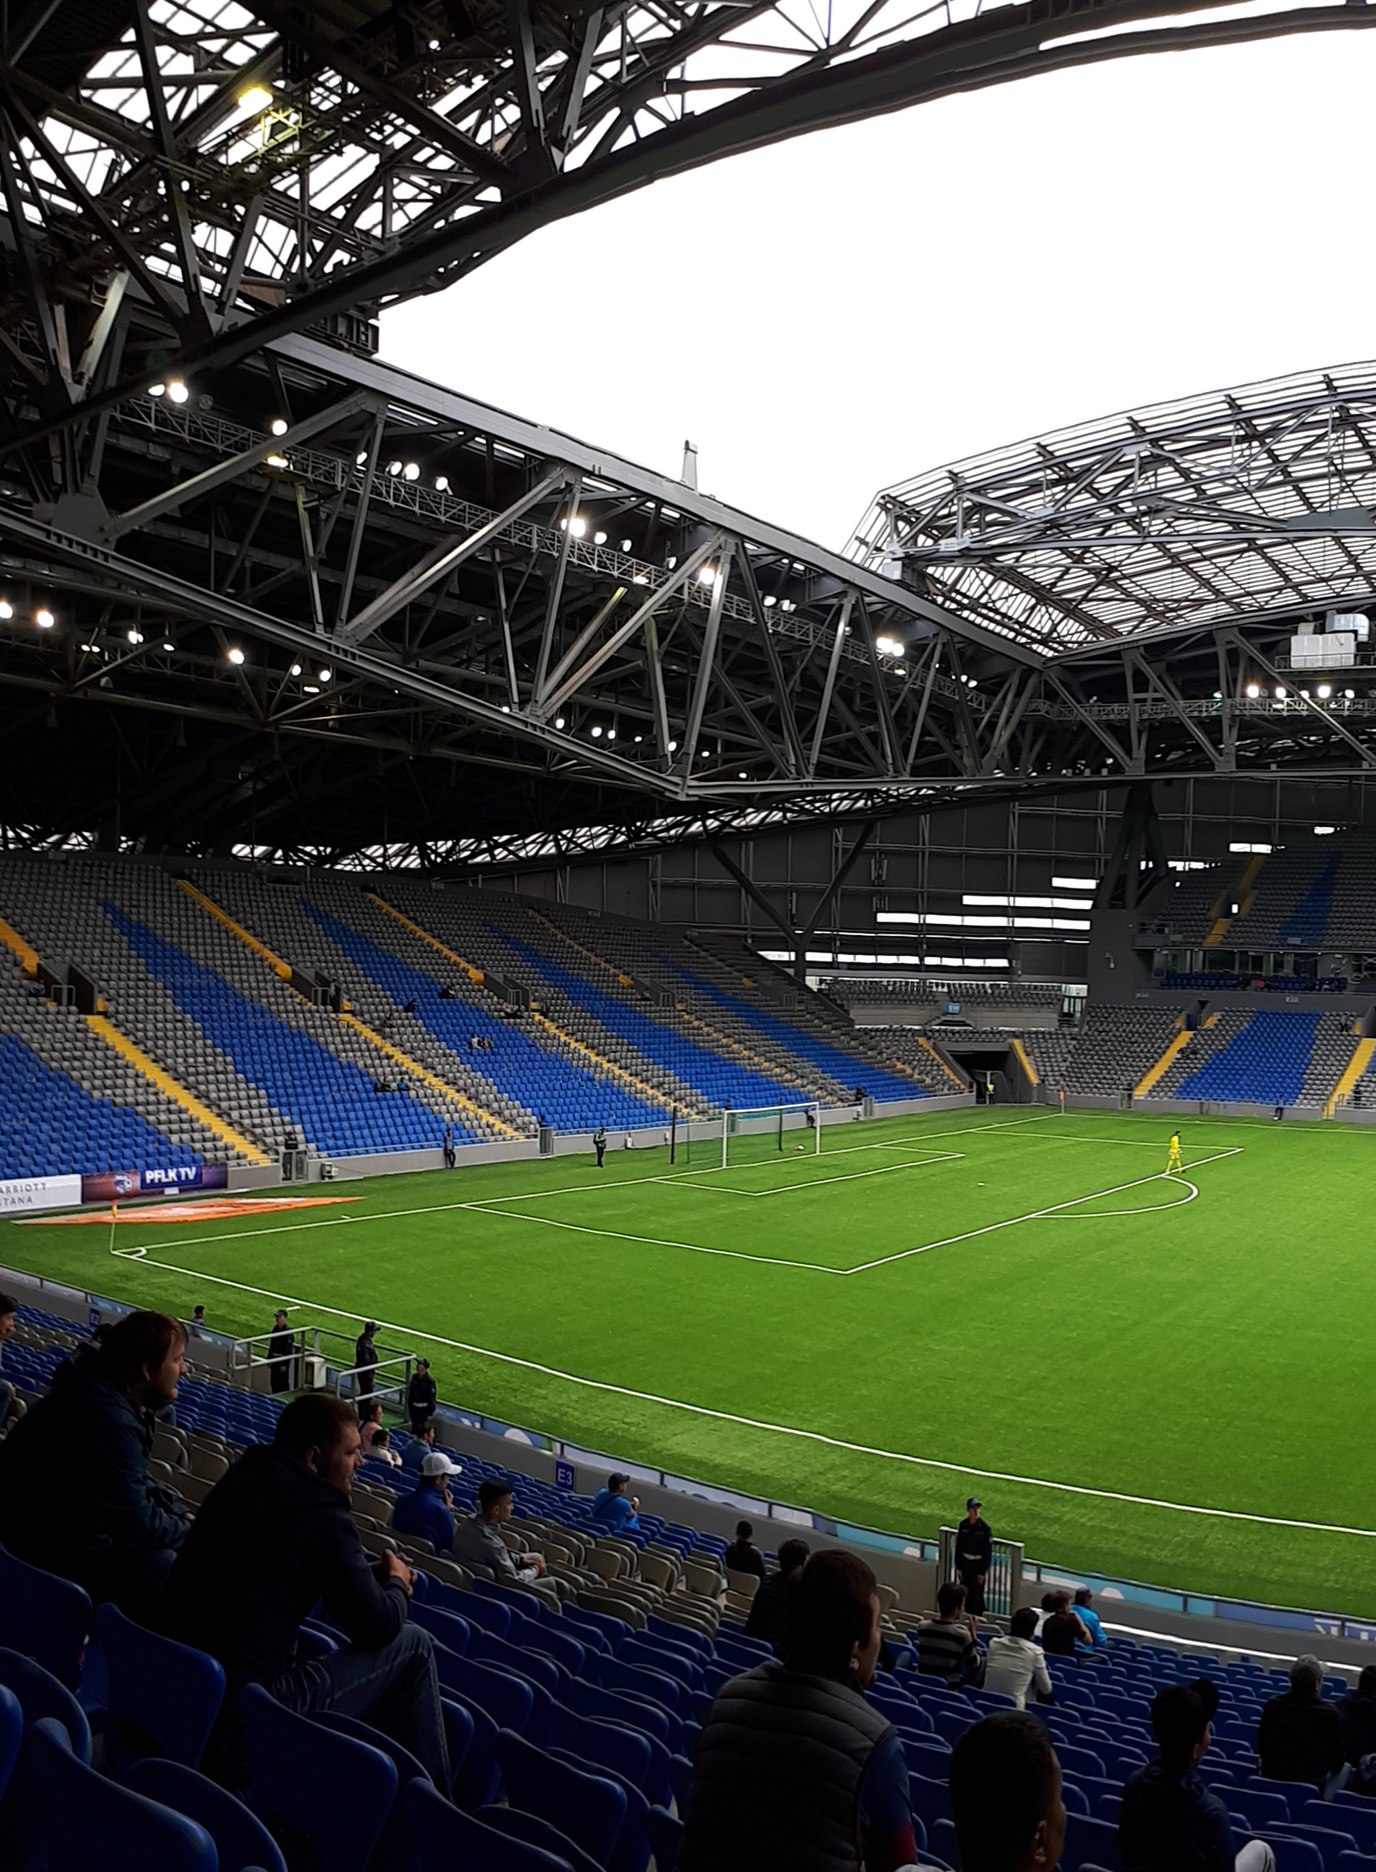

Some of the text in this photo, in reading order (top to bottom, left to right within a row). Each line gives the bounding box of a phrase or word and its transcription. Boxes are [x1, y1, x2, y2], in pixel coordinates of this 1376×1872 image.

[145, 1166, 197, 1184] PFLK TV
[557, 1467, 573, 1486] E3
